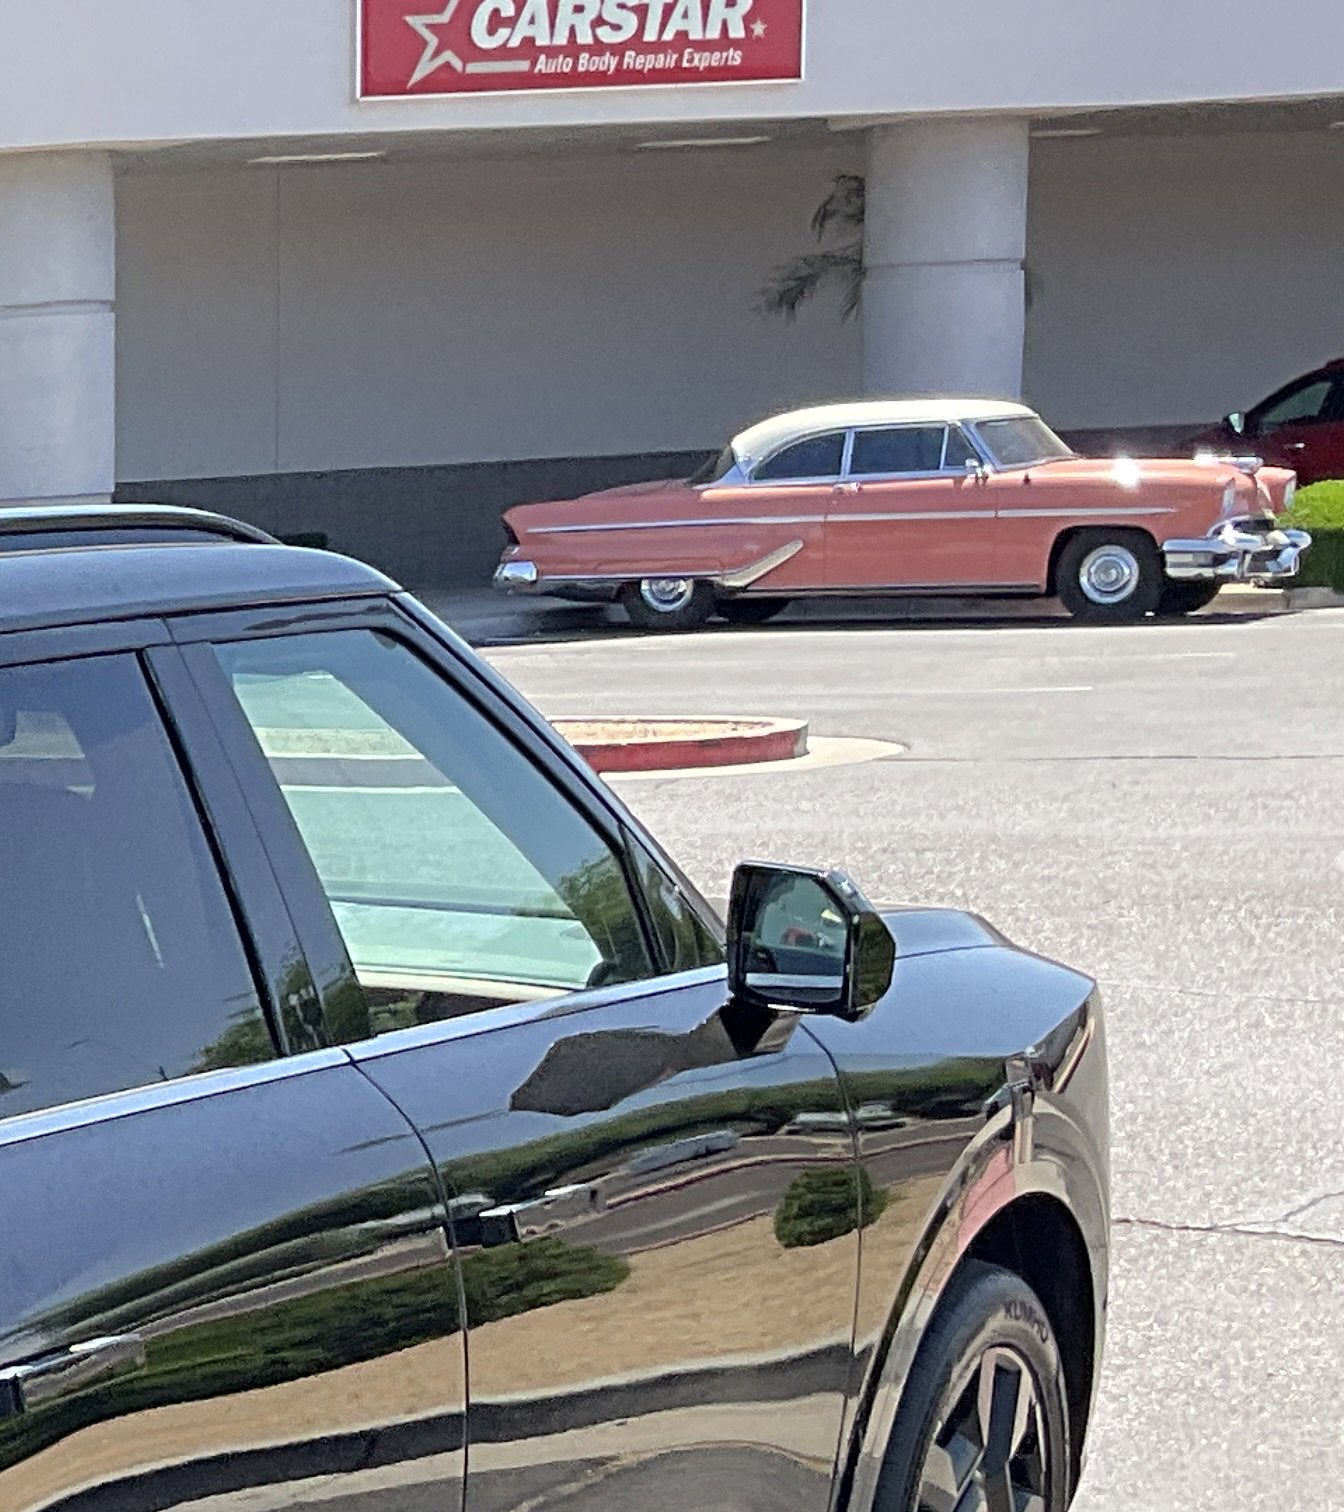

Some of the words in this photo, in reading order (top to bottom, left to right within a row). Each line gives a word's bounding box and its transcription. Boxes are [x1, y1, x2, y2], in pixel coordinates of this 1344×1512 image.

[469, 0, 754, 49] CARSTAR
[534, 53, 572, 74] Auto
[577, 51, 618, 74] Body
[623, 49, 678, 72] Repair
[682, 47, 743, 71] Experts
